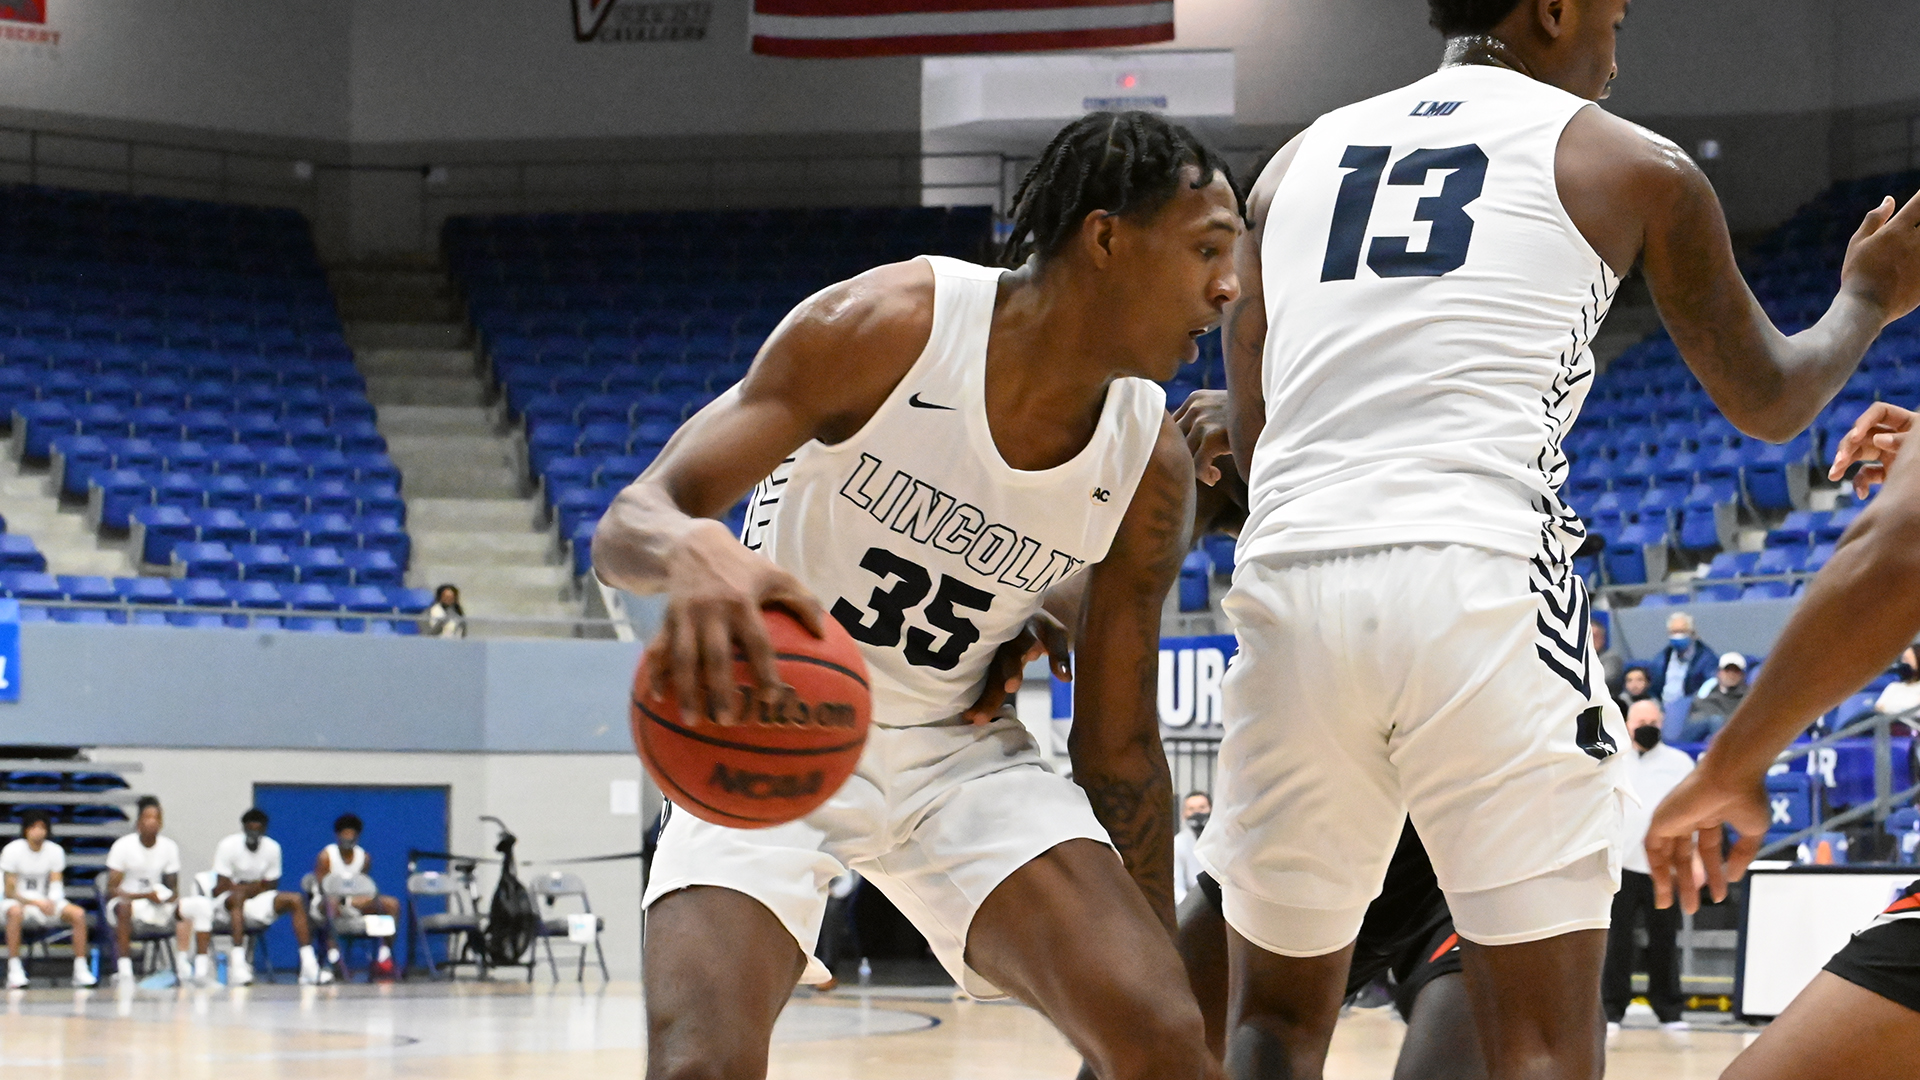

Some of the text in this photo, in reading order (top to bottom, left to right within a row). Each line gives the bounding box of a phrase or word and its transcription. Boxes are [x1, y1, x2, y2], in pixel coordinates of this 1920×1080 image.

[0, 26, 61, 46] BERRY
[1319, 143, 1490, 283] 13
[839, 451, 1086, 594] LINCOLN
[830, 546, 997, 672] 35
